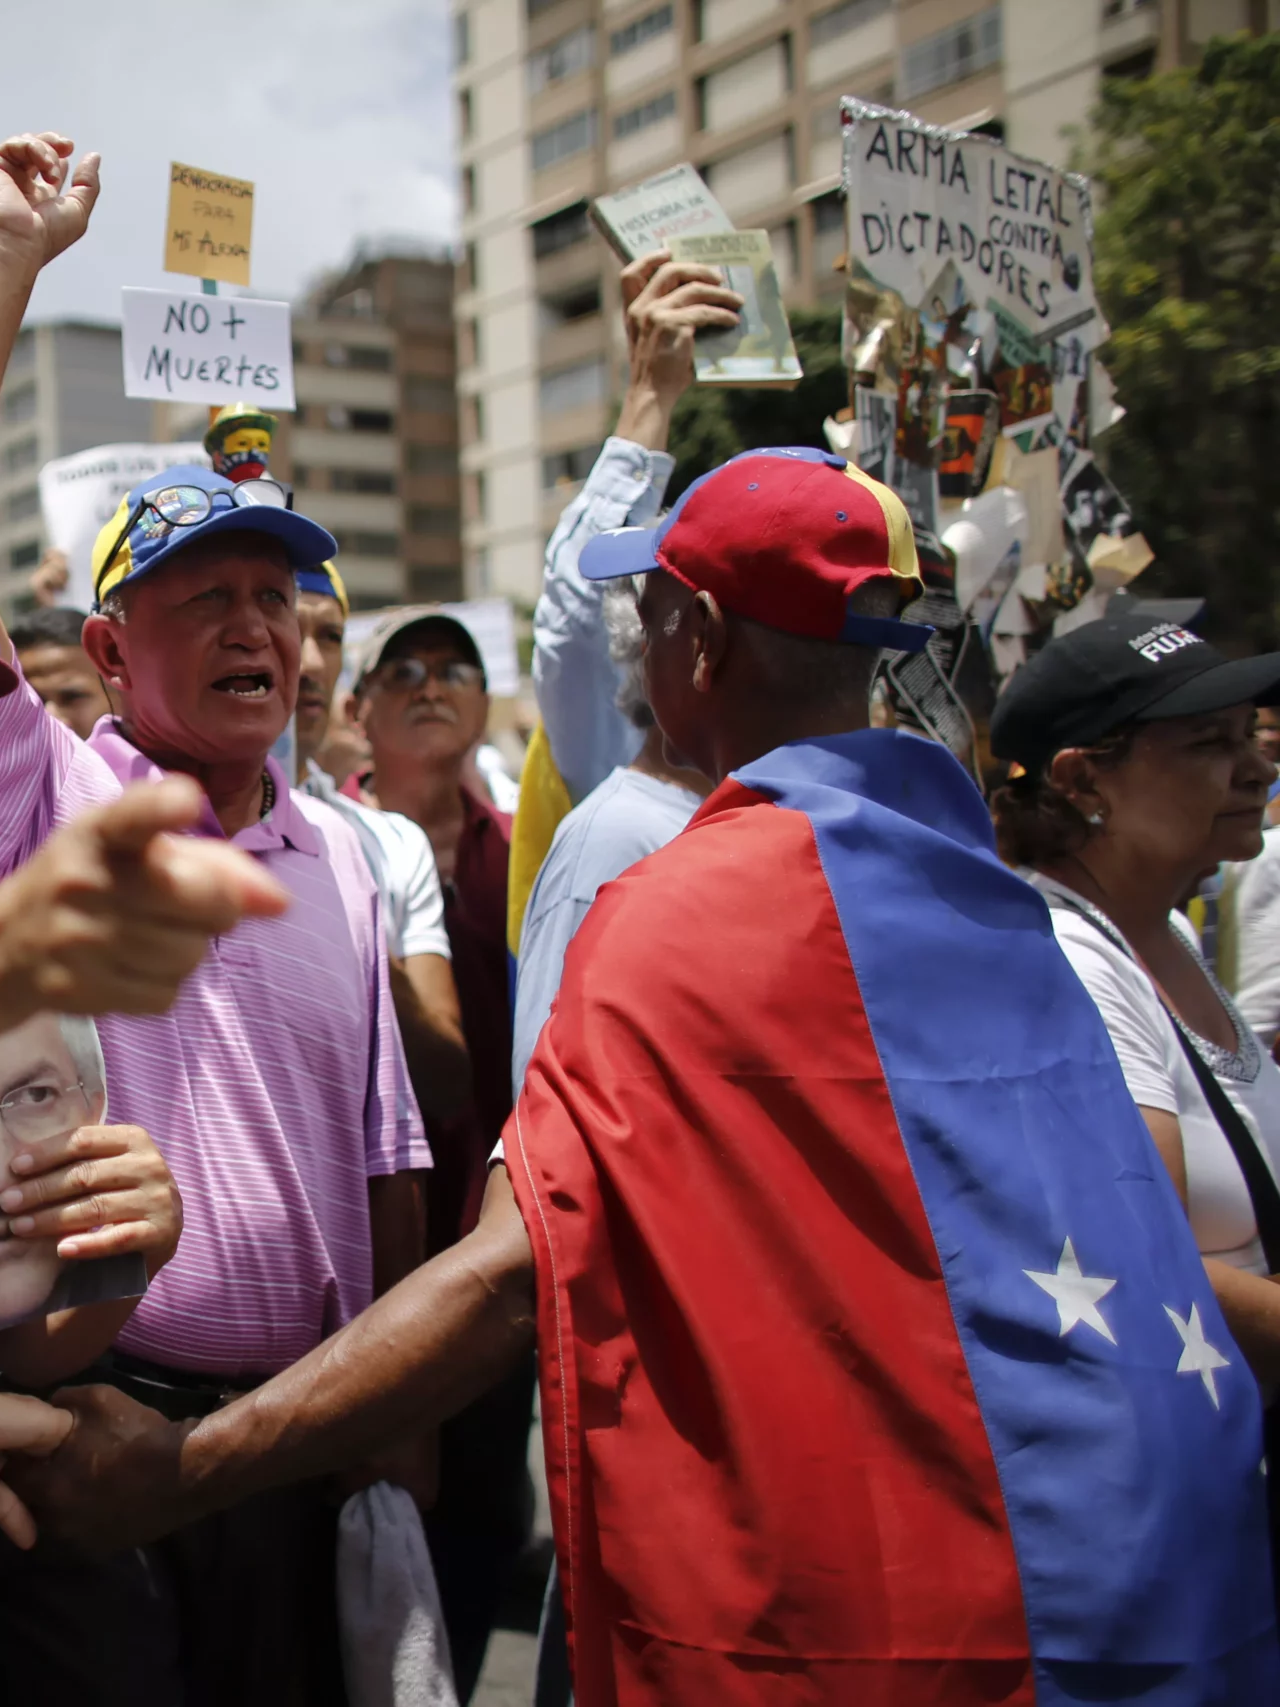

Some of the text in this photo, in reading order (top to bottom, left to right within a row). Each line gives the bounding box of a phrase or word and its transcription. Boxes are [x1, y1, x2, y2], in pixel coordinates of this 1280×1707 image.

[866, 122, 1071, 227] ARMA LETAL
[988, 215, 1065, 265] CONTRA
[163, 300, 210, 334] NO
[144, 344, 280, 393] MUERTES
